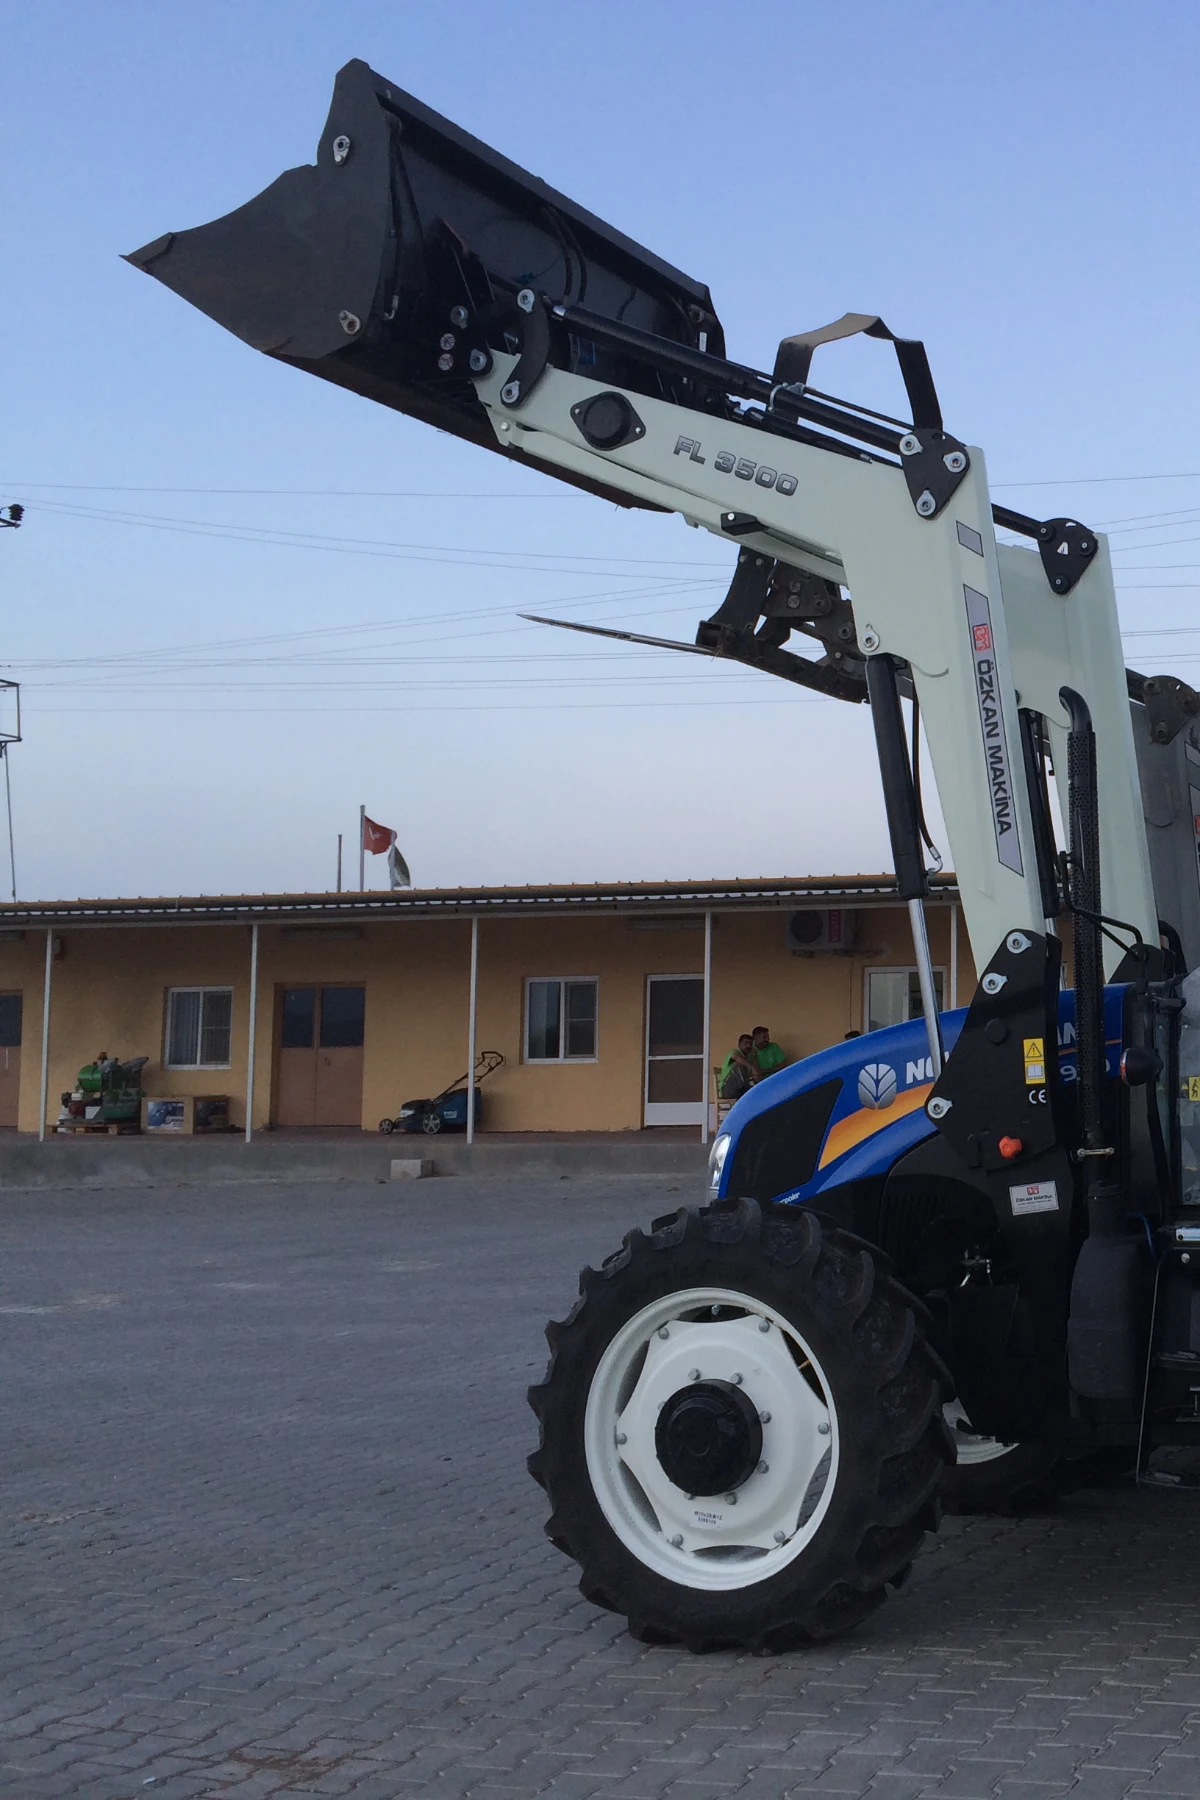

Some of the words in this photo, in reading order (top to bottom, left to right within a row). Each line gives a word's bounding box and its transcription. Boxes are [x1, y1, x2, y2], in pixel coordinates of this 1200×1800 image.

[673, 435, 706, 465] FL
[714, 450, 799, 497] 3500
[977, 658, 1001, 739] ÖZKAN
[987, 744, 1012, 836] MAKİNA
[1028, 1089, 1047, 1104] CE
